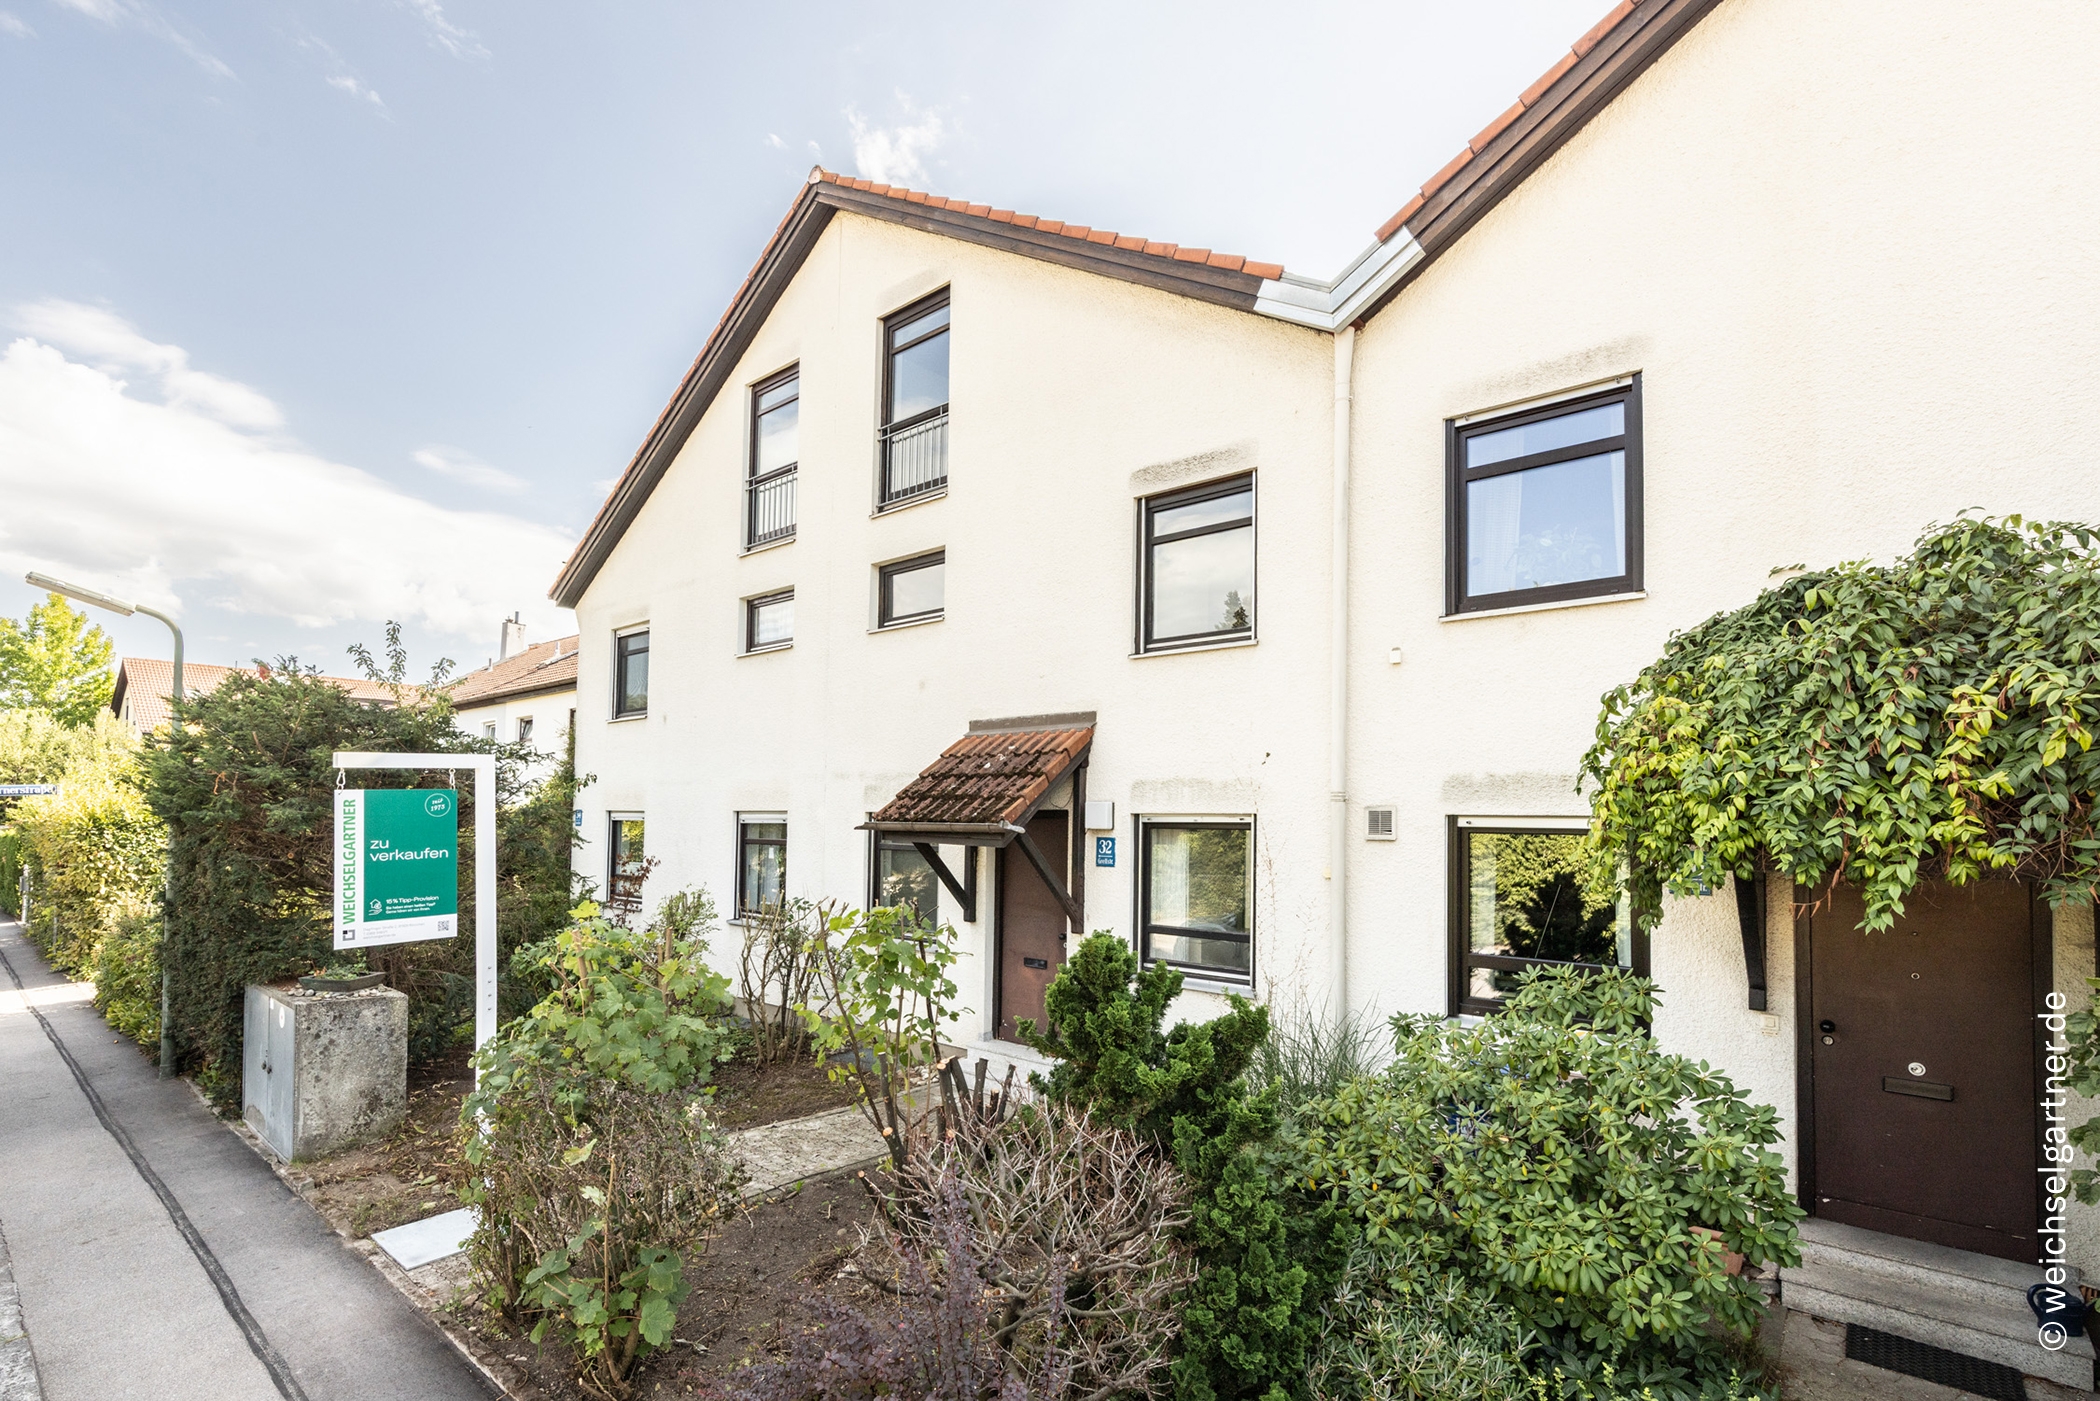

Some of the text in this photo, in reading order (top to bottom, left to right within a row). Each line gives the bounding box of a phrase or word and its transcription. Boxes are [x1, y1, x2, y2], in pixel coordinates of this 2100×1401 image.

[370, 840, 389, 849] zu
[1099, 839, 1113, 854] 32
[342, 799, 356, 925] WEICHSELGARTNER
[370, 847, 449, 862] verkaufen
